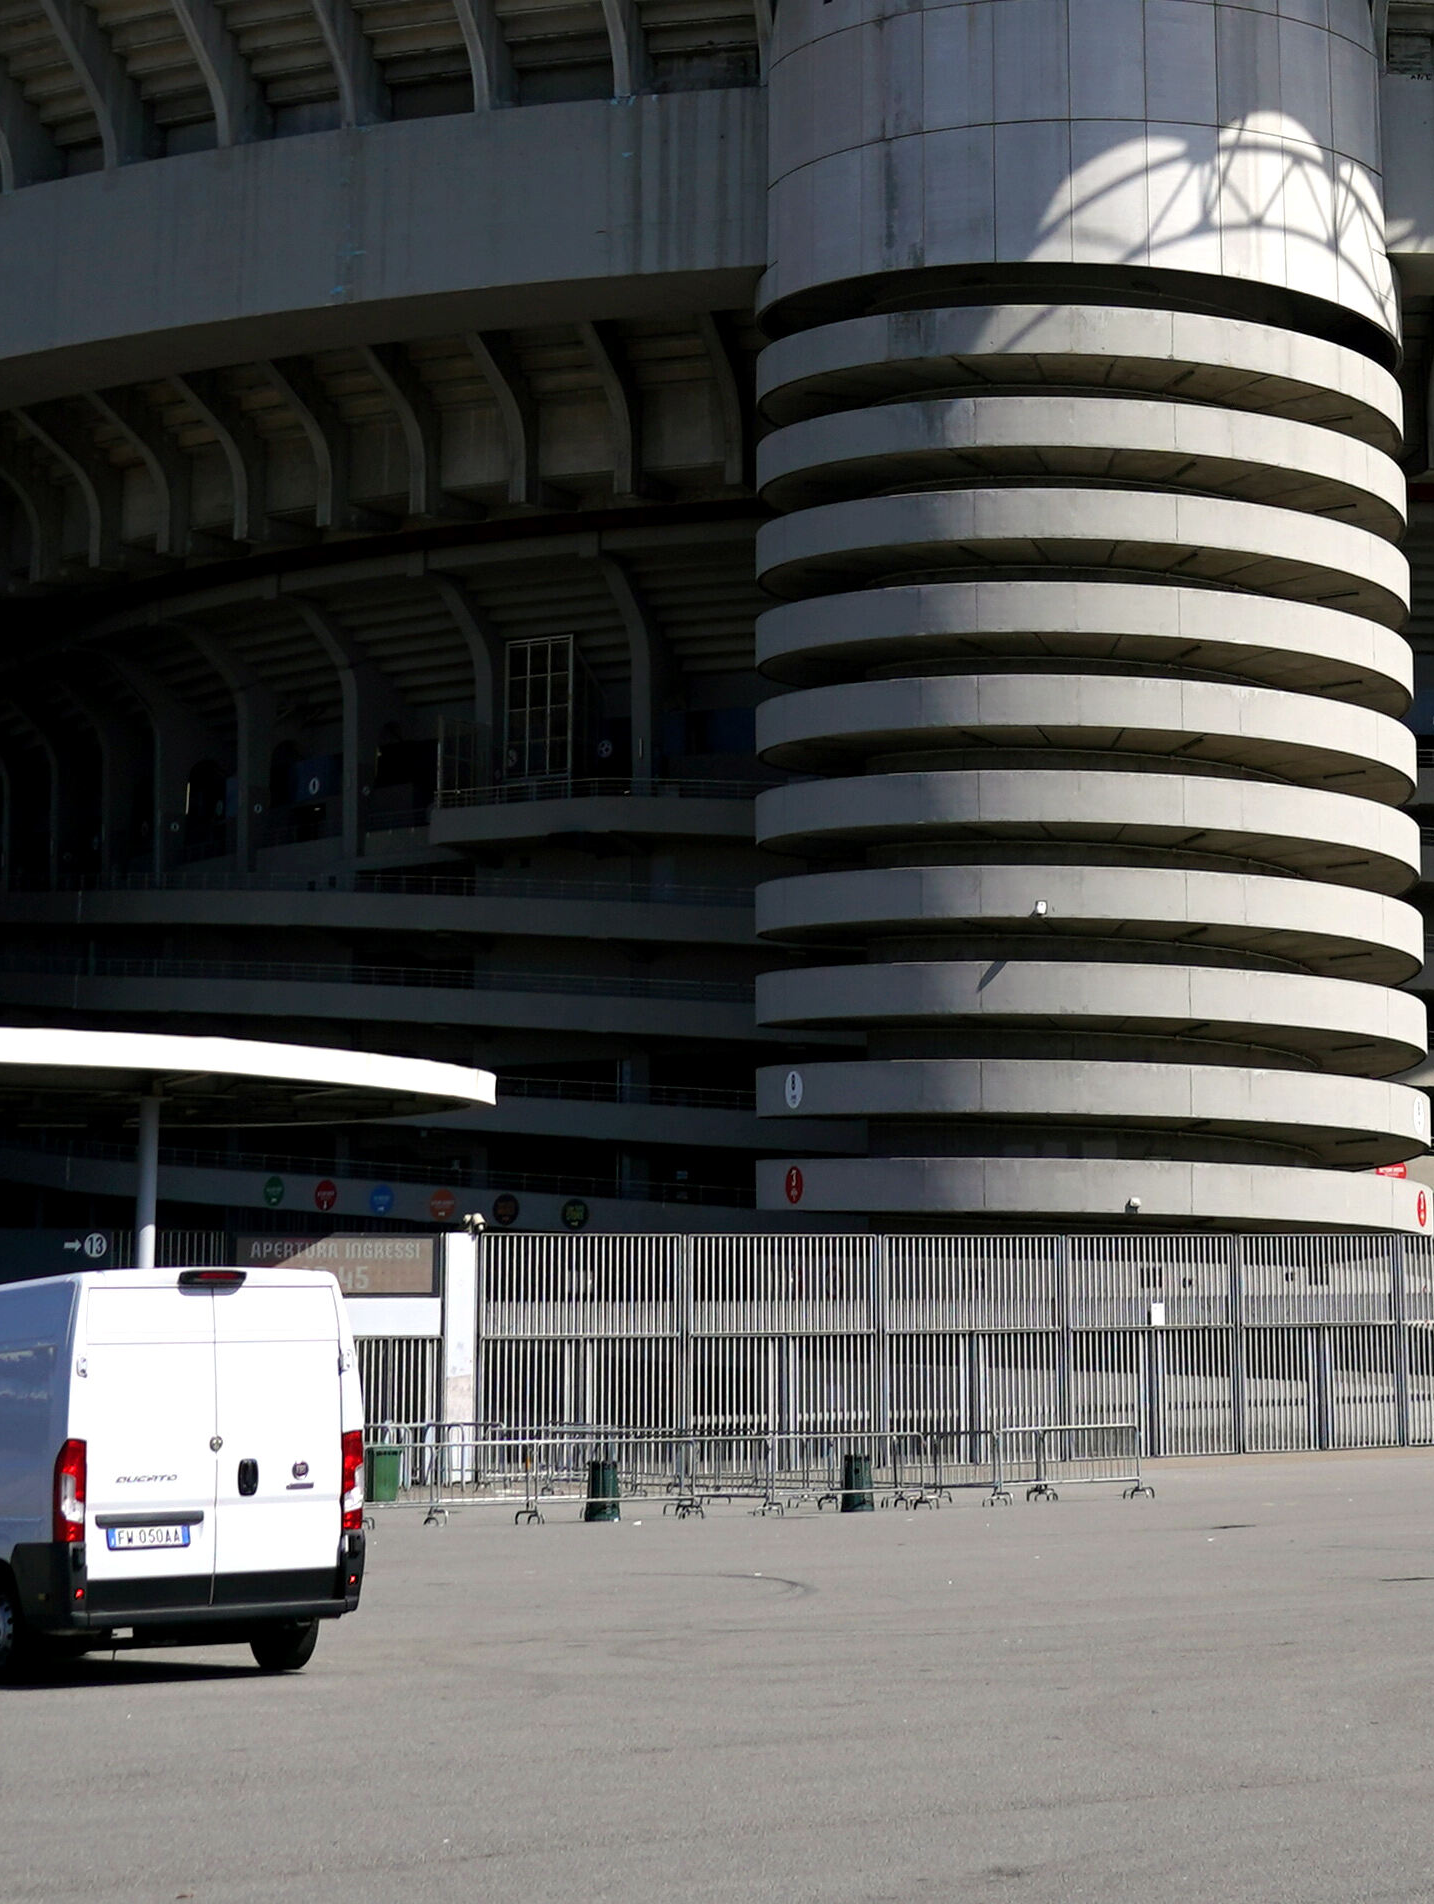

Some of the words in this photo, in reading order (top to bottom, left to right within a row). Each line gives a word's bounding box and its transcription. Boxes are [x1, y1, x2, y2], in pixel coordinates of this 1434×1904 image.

[87, 1236, 104, 1255] 13
[250, 1240, 339, 1259] APERTURA
[345, 1241, 421, 1259] INGRESSI
[115, 1473, 178, 1484] DUCATO
[117, 1529, 134, 1545] FW
[139, 1527, 181, 1544] 050AA
